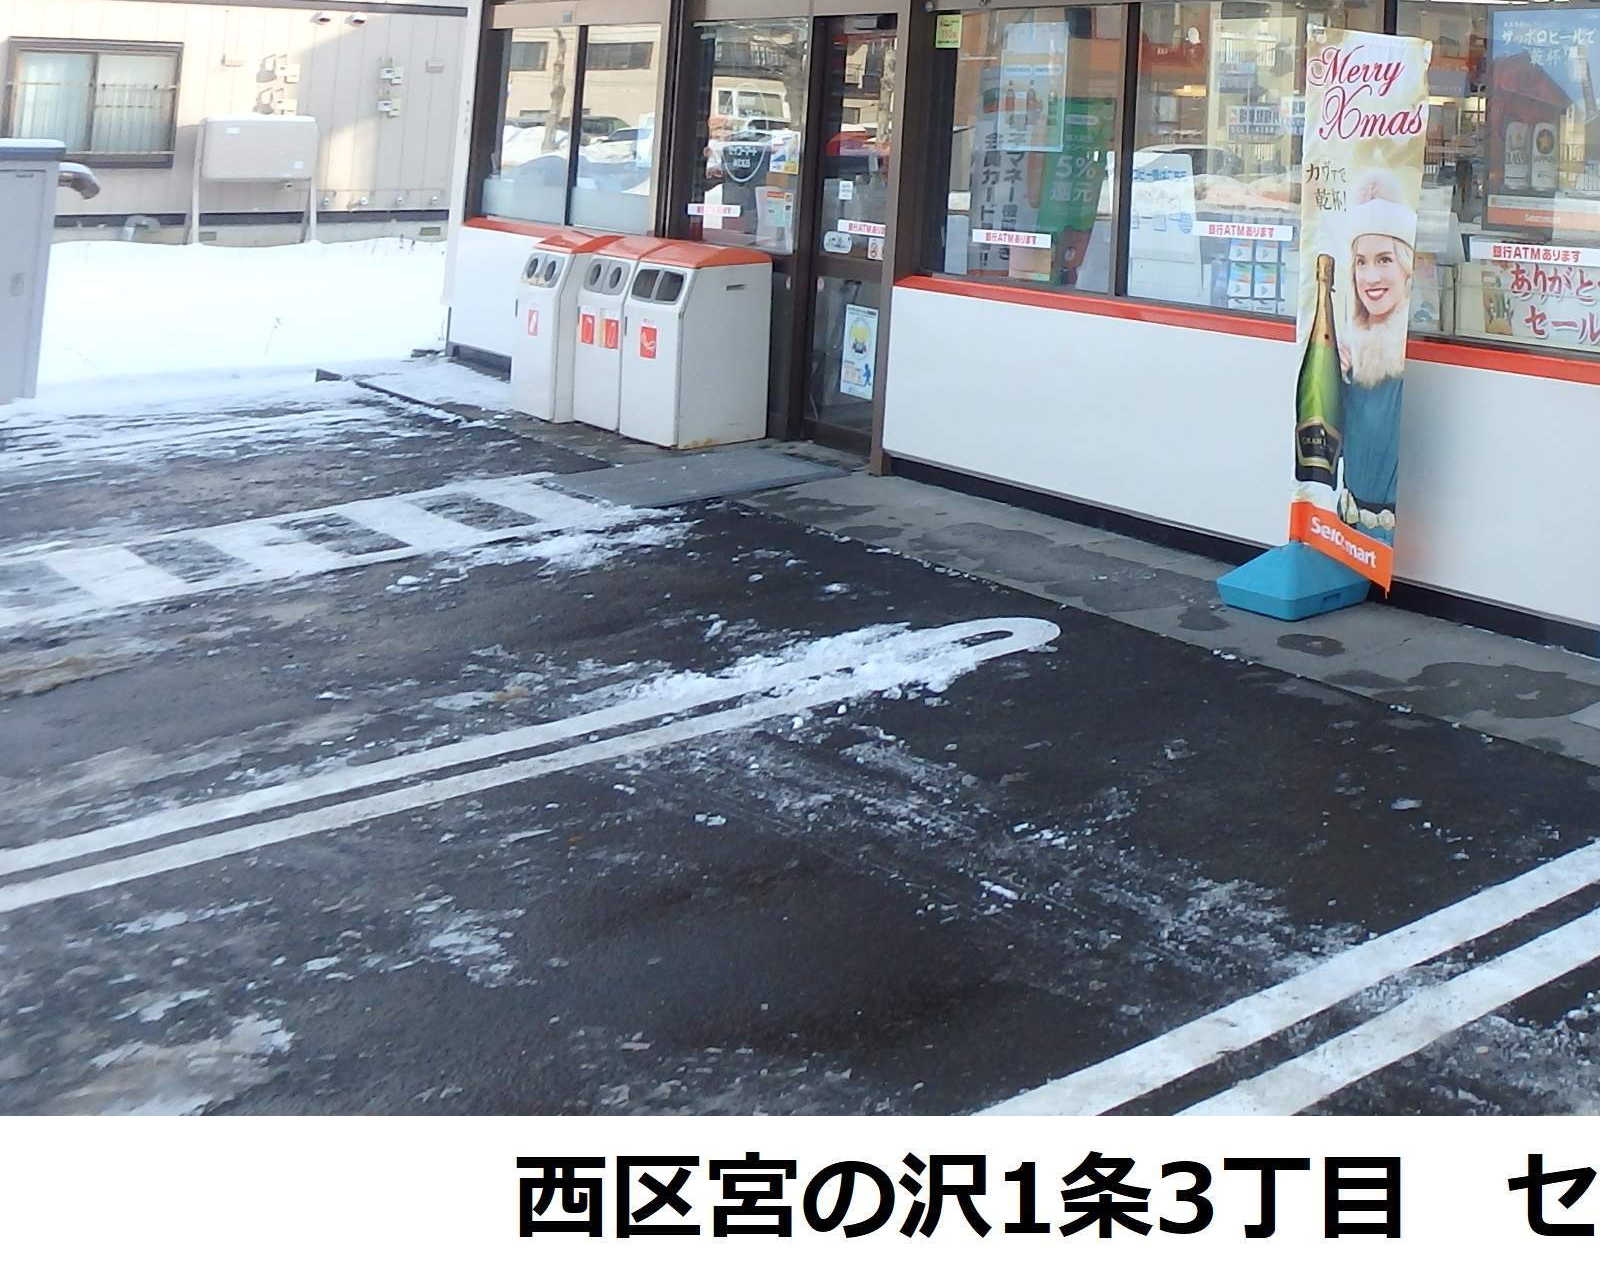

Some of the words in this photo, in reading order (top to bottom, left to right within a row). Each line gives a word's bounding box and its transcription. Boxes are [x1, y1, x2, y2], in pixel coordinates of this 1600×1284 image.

[1308, 44, 1404, 97] Merry
[1319, 84, 1423, 140] Xmas
[1055, 155, 1096, 180] 5%
[1314, 187, 1348, 213] 乾杯!
[985, 232, 1037, 245] 銀行ATMあります
[1207, 223, 1276, 238] 銀行ATMあります
[1491, 245, 1582, 263] 銀行ATMあります
